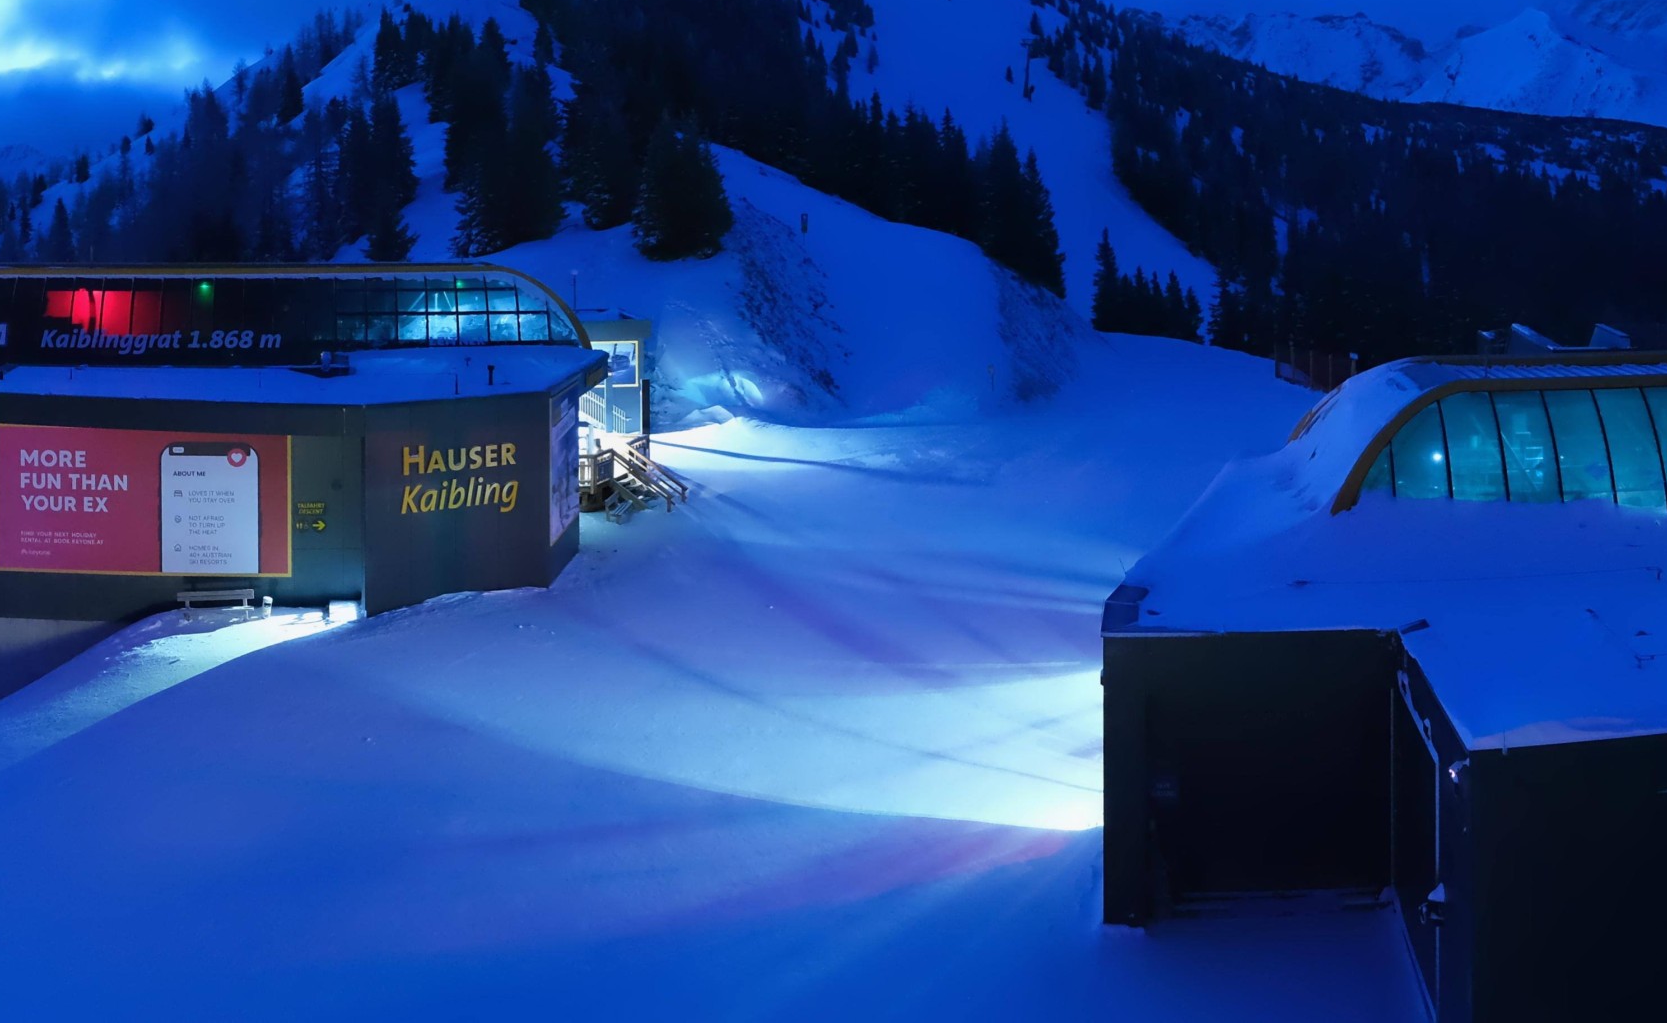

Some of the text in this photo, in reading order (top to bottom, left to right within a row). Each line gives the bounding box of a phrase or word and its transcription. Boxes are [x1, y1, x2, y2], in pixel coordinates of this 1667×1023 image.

[40, 328, 282, 355] Kaiblinggrat 1.868 m
[20, 449, 87, 468] MORE
[402, 442, 517, 476] HAUSER
[20, 472, 128, 491] FUN THAN
[20, 494, 109, 513] YOUR EX
[400, 477, 519, 514] Kaibling
